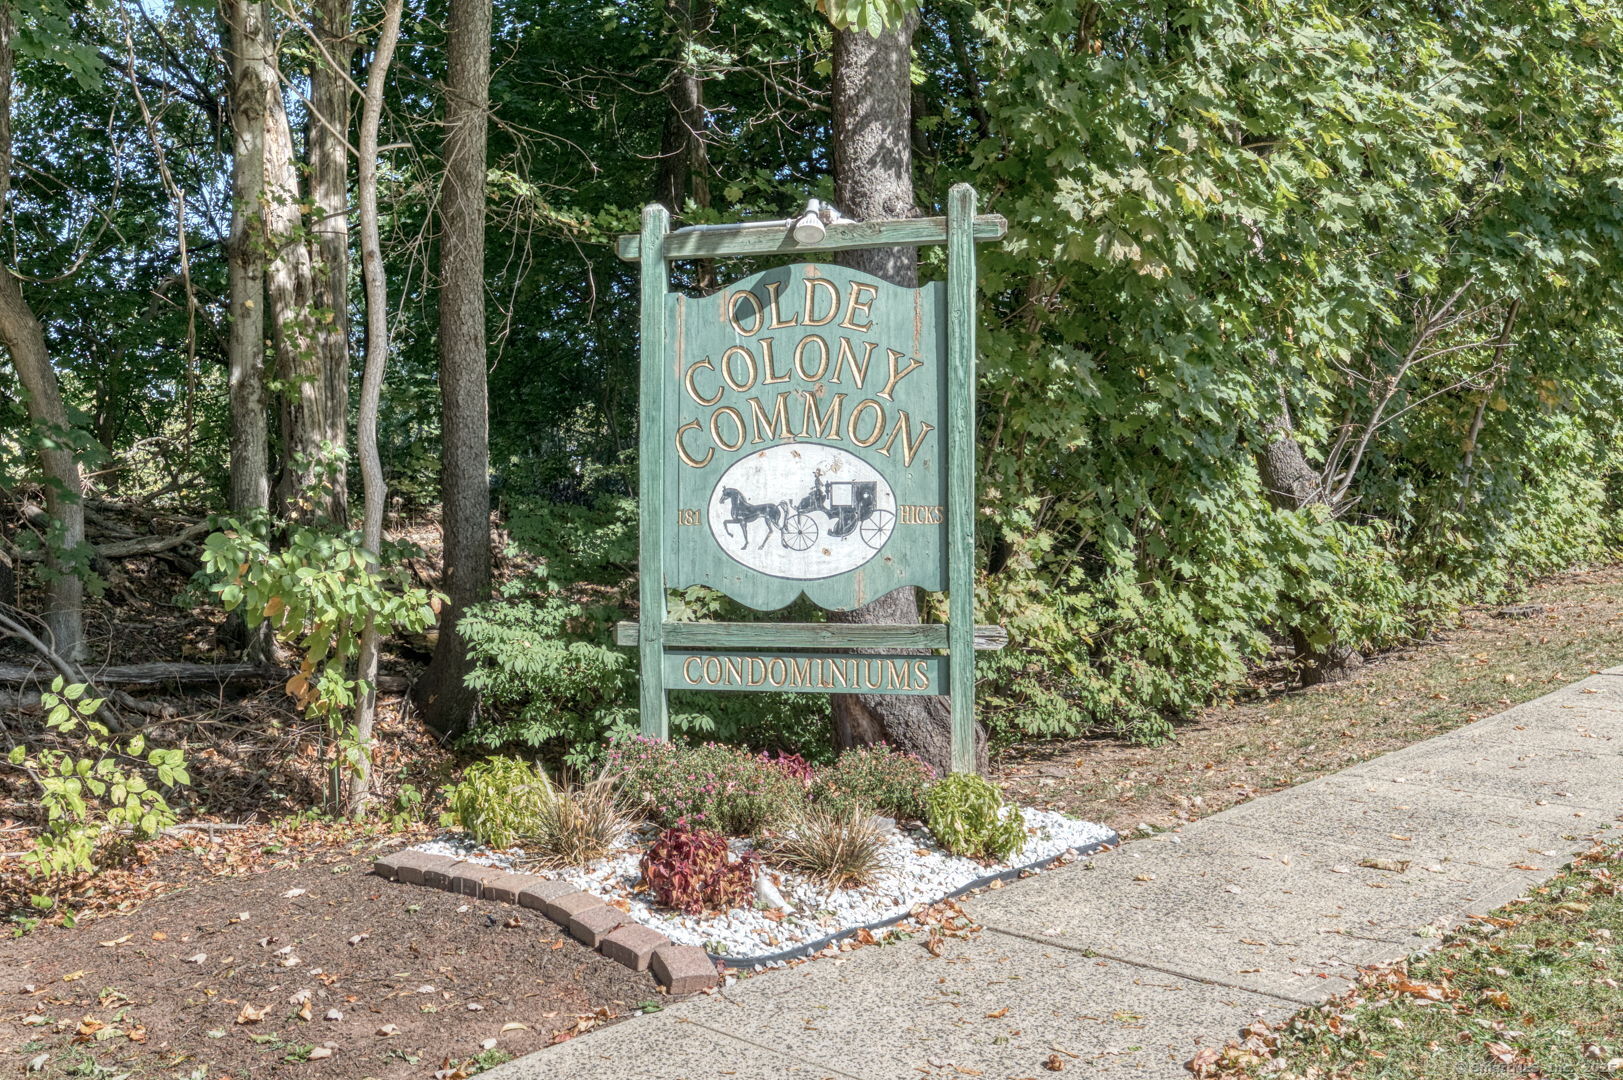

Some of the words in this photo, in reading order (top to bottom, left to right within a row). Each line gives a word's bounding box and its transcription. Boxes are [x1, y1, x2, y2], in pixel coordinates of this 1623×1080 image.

[727, 277, 879, 337] OLDE
[684, 333, 924, 407] COLONY
[674, 390, 935, 468] COMMON
[677, 508, 702, 526] 181
[899, 504, 945, 525] HICKS
[682, 655, 930, 691] CONDOMINIUMS
